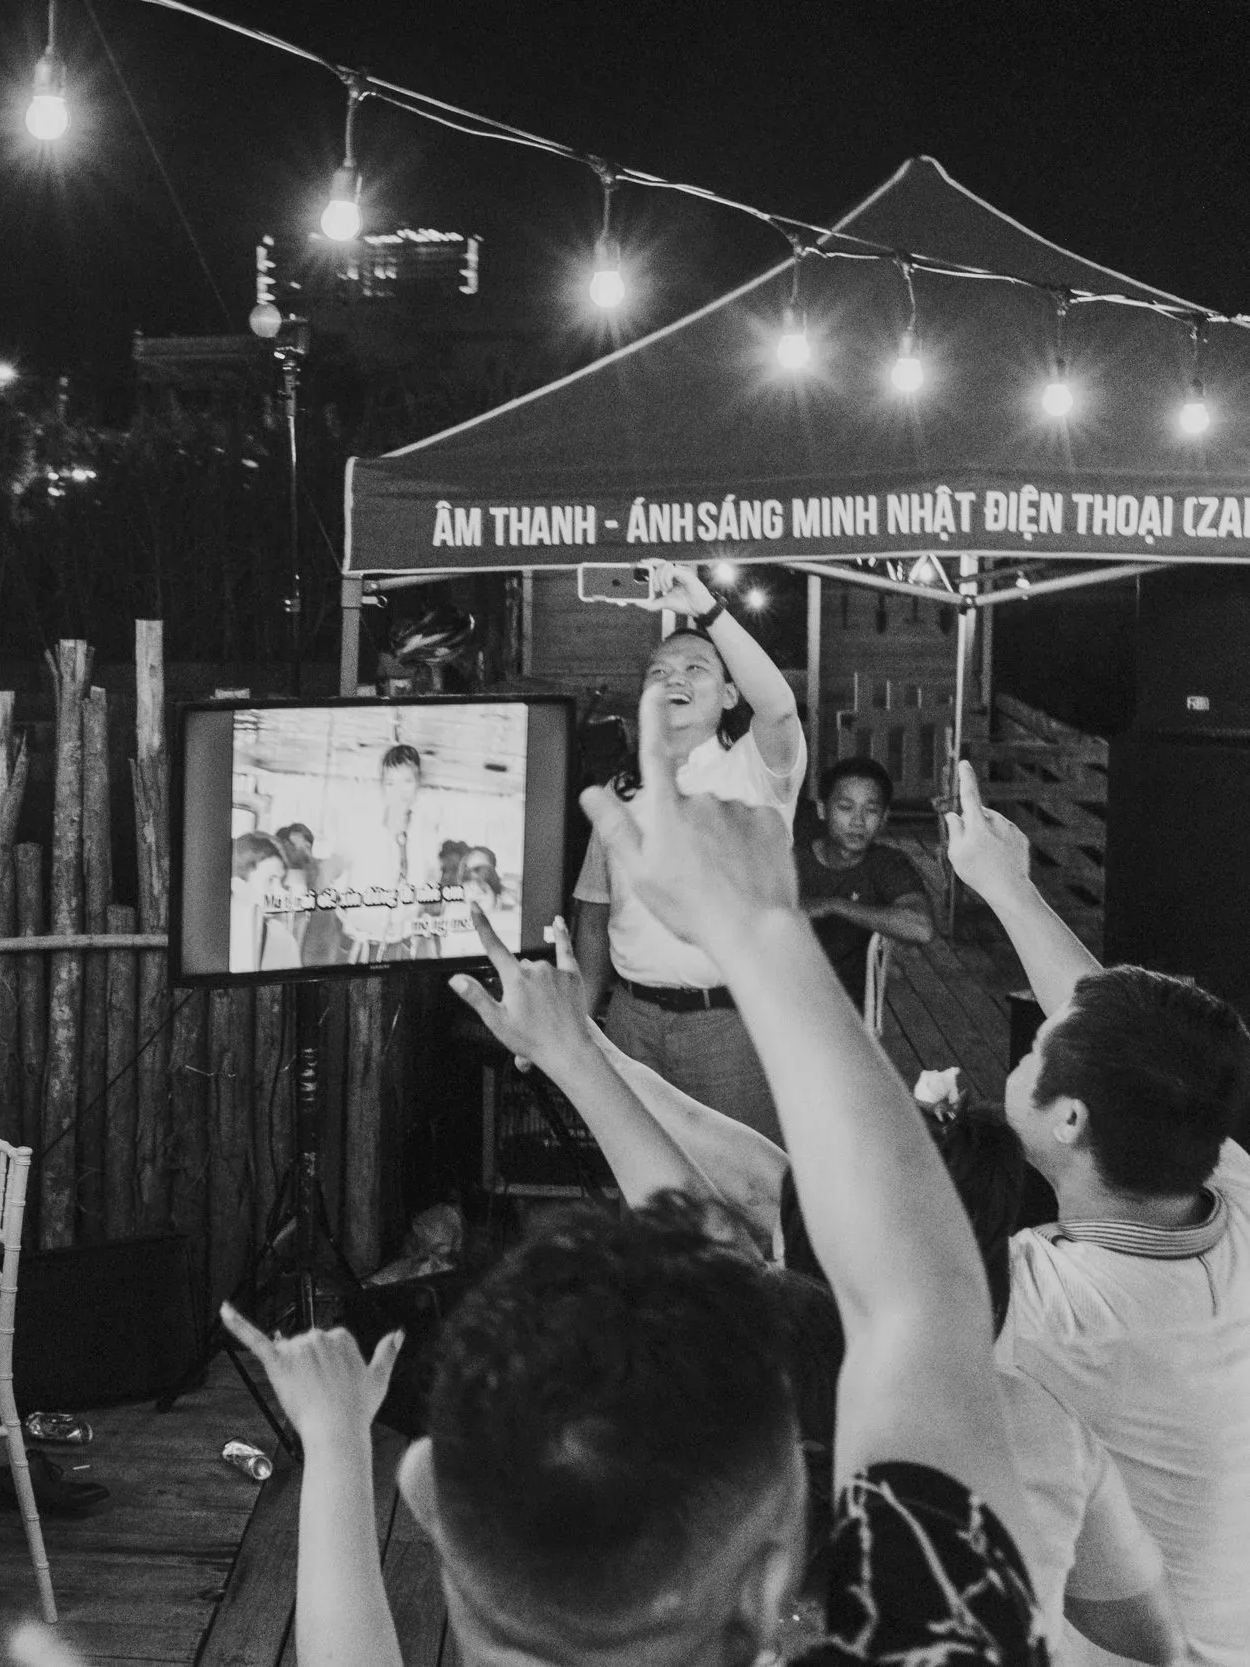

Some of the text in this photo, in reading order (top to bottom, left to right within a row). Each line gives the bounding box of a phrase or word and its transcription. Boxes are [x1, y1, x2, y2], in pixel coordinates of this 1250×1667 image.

[432, 500, 482, 547] ÂM
[489, 505, 596, 546] THANH
[792, 494, 878, 538] MINH
[886, 484, 977, 542] NHẬT
[983, 484, 1064, 542] ĐIỆN
[1071, 492, 1174, 545] THOẠI
